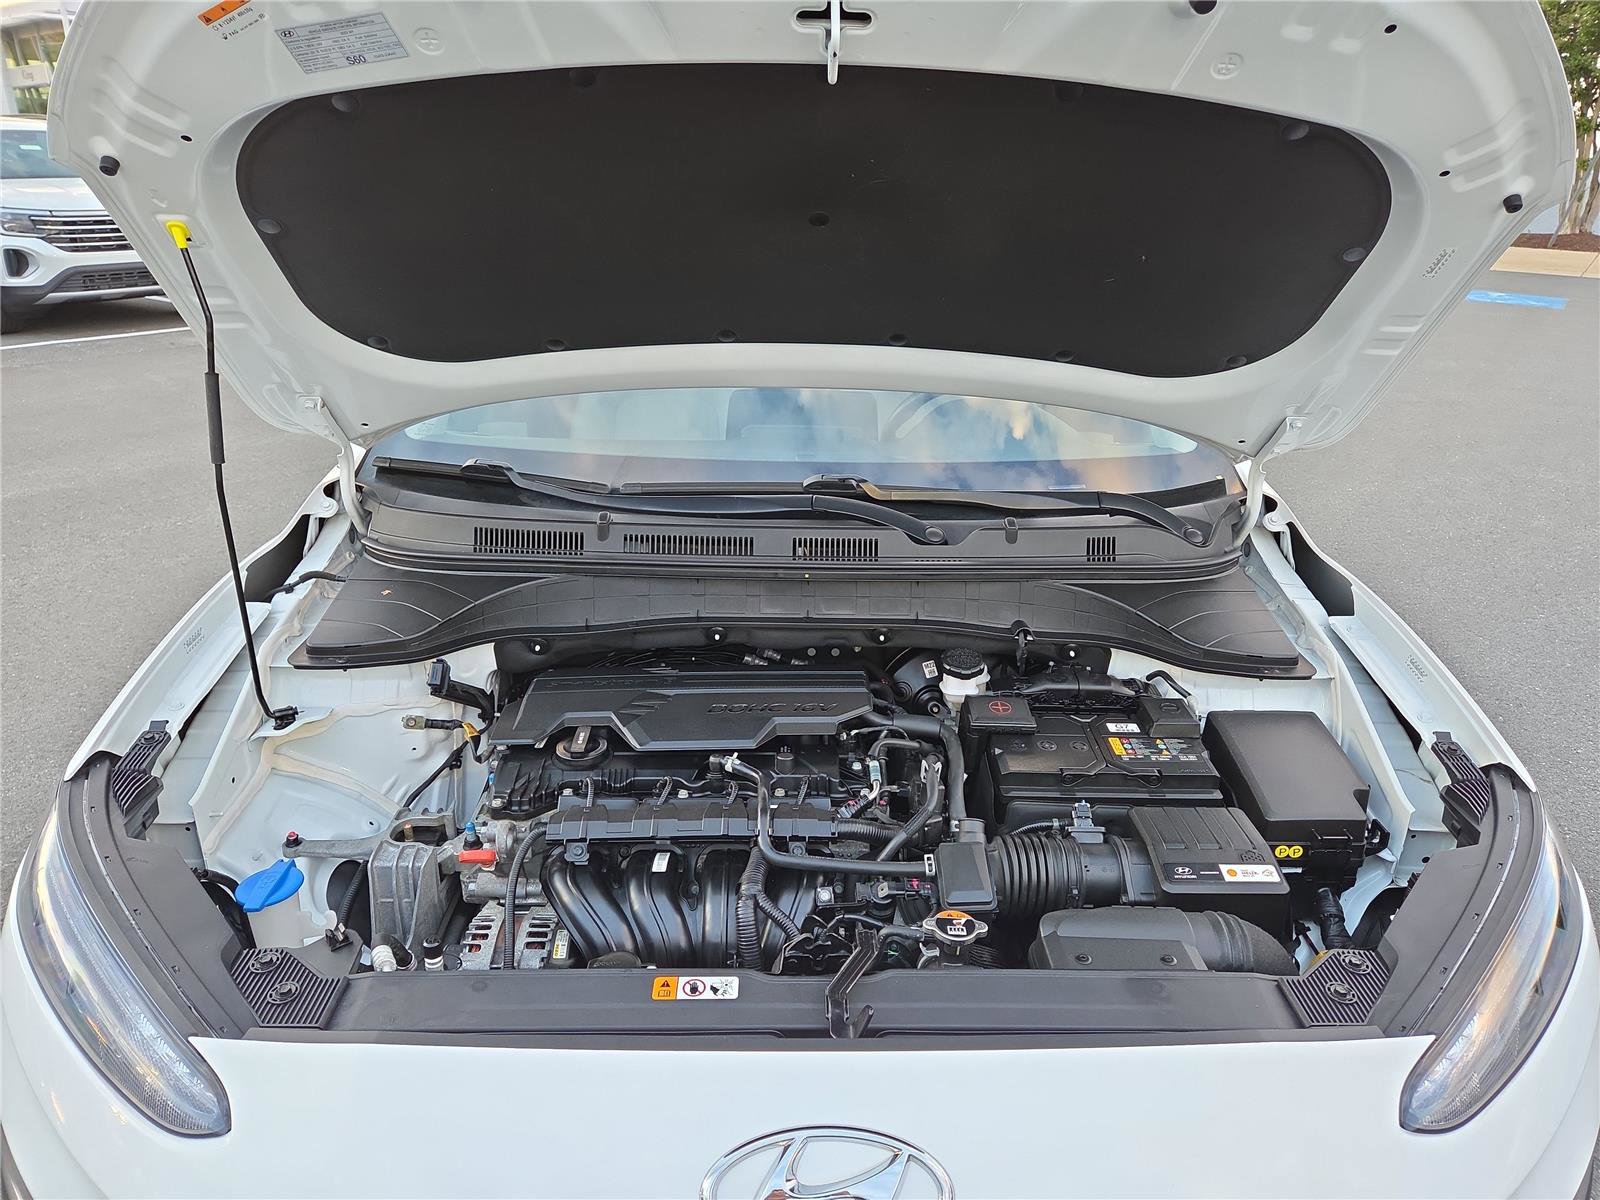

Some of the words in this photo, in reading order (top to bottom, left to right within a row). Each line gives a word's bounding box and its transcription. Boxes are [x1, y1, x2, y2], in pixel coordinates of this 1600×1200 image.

[346, 55, 366, 65] S60
[707, 703, 787, 714] DOHC
[792, 702, 839, 713] 16V
